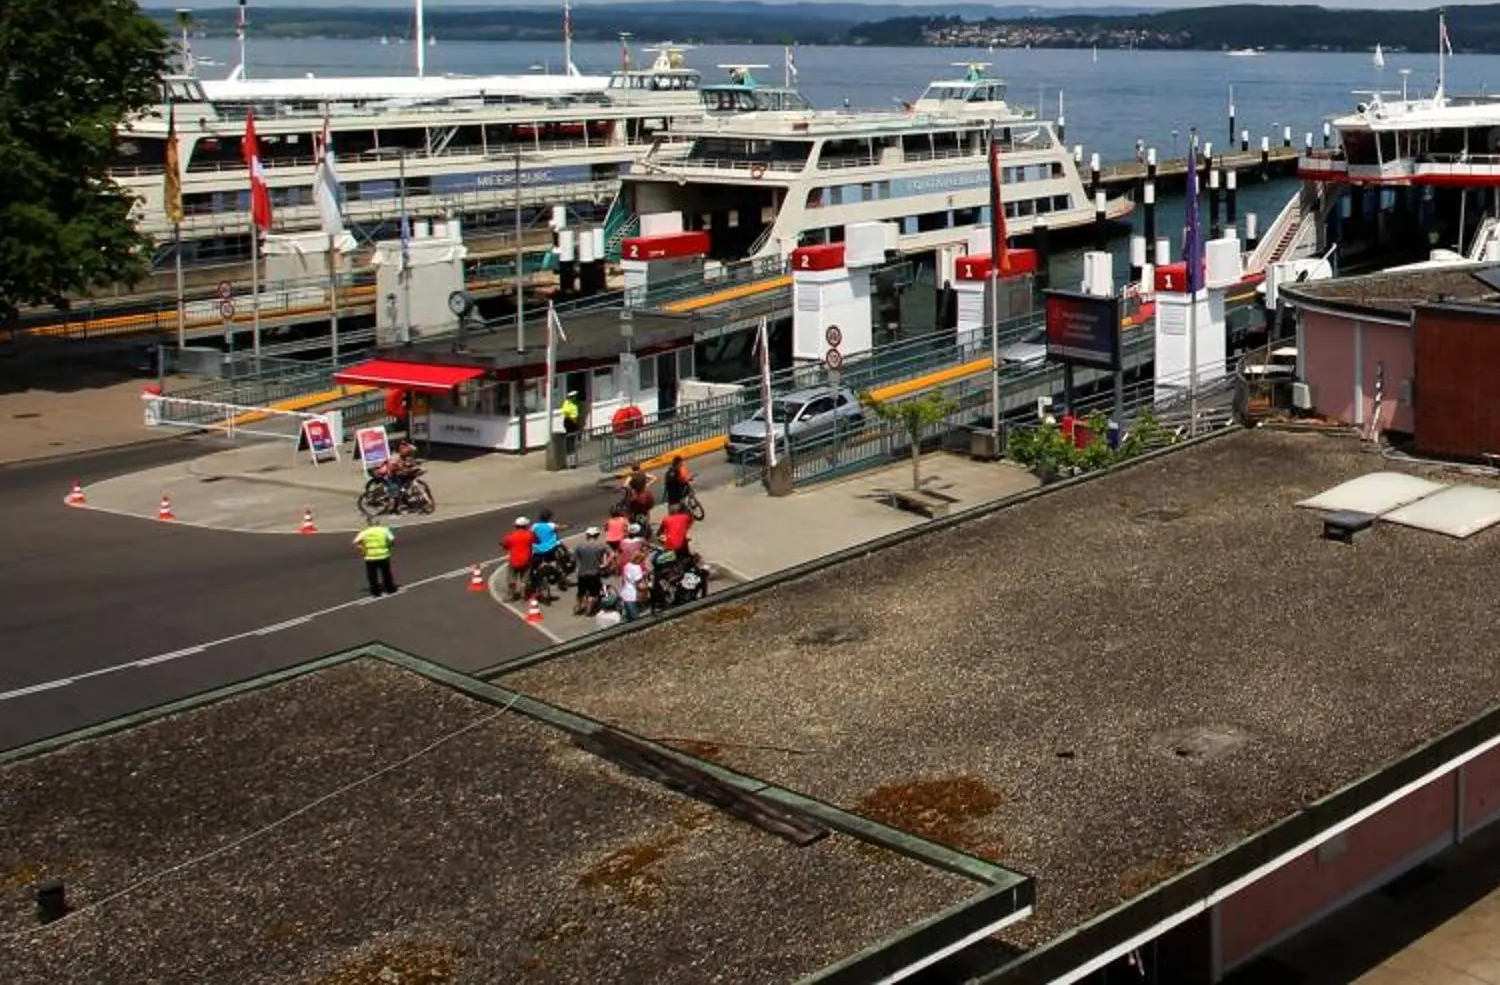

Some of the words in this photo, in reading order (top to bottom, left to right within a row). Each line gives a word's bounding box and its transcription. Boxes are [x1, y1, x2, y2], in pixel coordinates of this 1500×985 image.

[477, 170, 553, 188] MEERBURG
[629, 244, 639, 258] 2
[801, 254, 810, 268] 2
[964, 264, 973, 278] 1
[1164, 274, 1173, 289] 1
